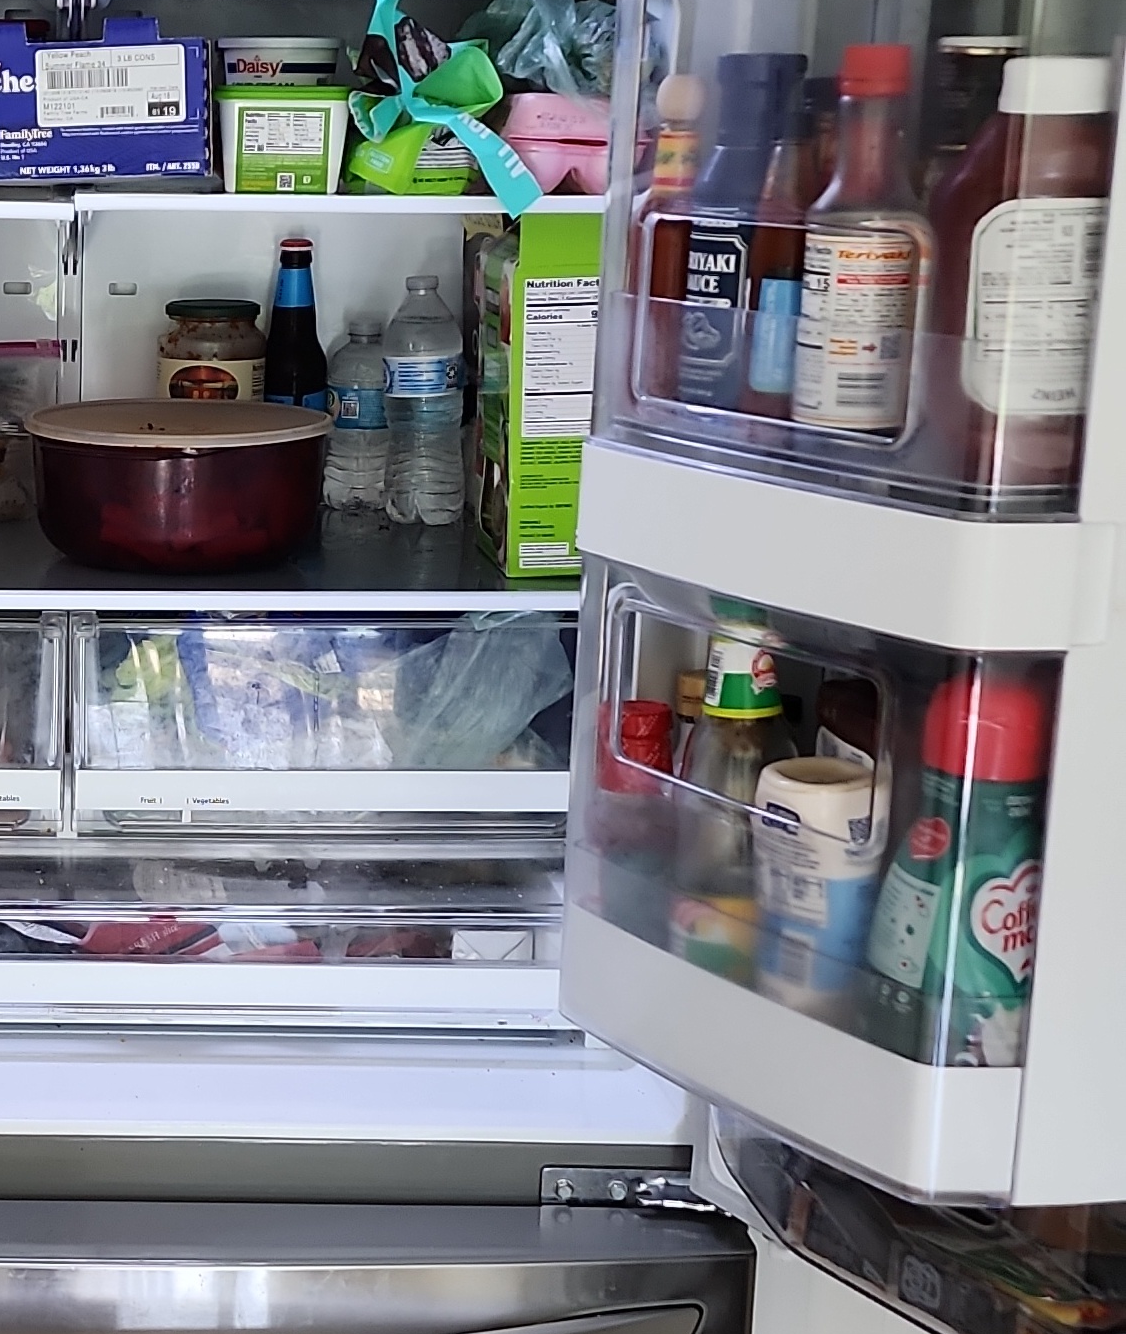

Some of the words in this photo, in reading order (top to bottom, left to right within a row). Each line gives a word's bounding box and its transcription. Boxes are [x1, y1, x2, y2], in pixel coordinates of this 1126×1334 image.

[46, 51, 69, 59] Yellow
[70, 50, 92, 58] Peach
[123, 54, 133, 62] LB
[74, 60, 96, 69] Flame
[236, 55, 281, 78] Daisy
[42, 102, 76, 111] M122101
[162, 105, 177, 117] 19
[0, 128, 53, 142] FamilyTree
[19, 167, 37, 176] NET
[38, 165, 71, 175] WEIGHT
[836, 248, 912, 261] Teriyaki
[525, 279, 574, 289] Nutrition
[576, 278, 600, 288] Fact
[816, 277, 831, 289] 15
[525, 312, 564, 321] Calories
[140, 796, 157, 804] Fruit
[191, 797, 230, 805] Vegetables
[981, 897, 1036, 935] Coff
